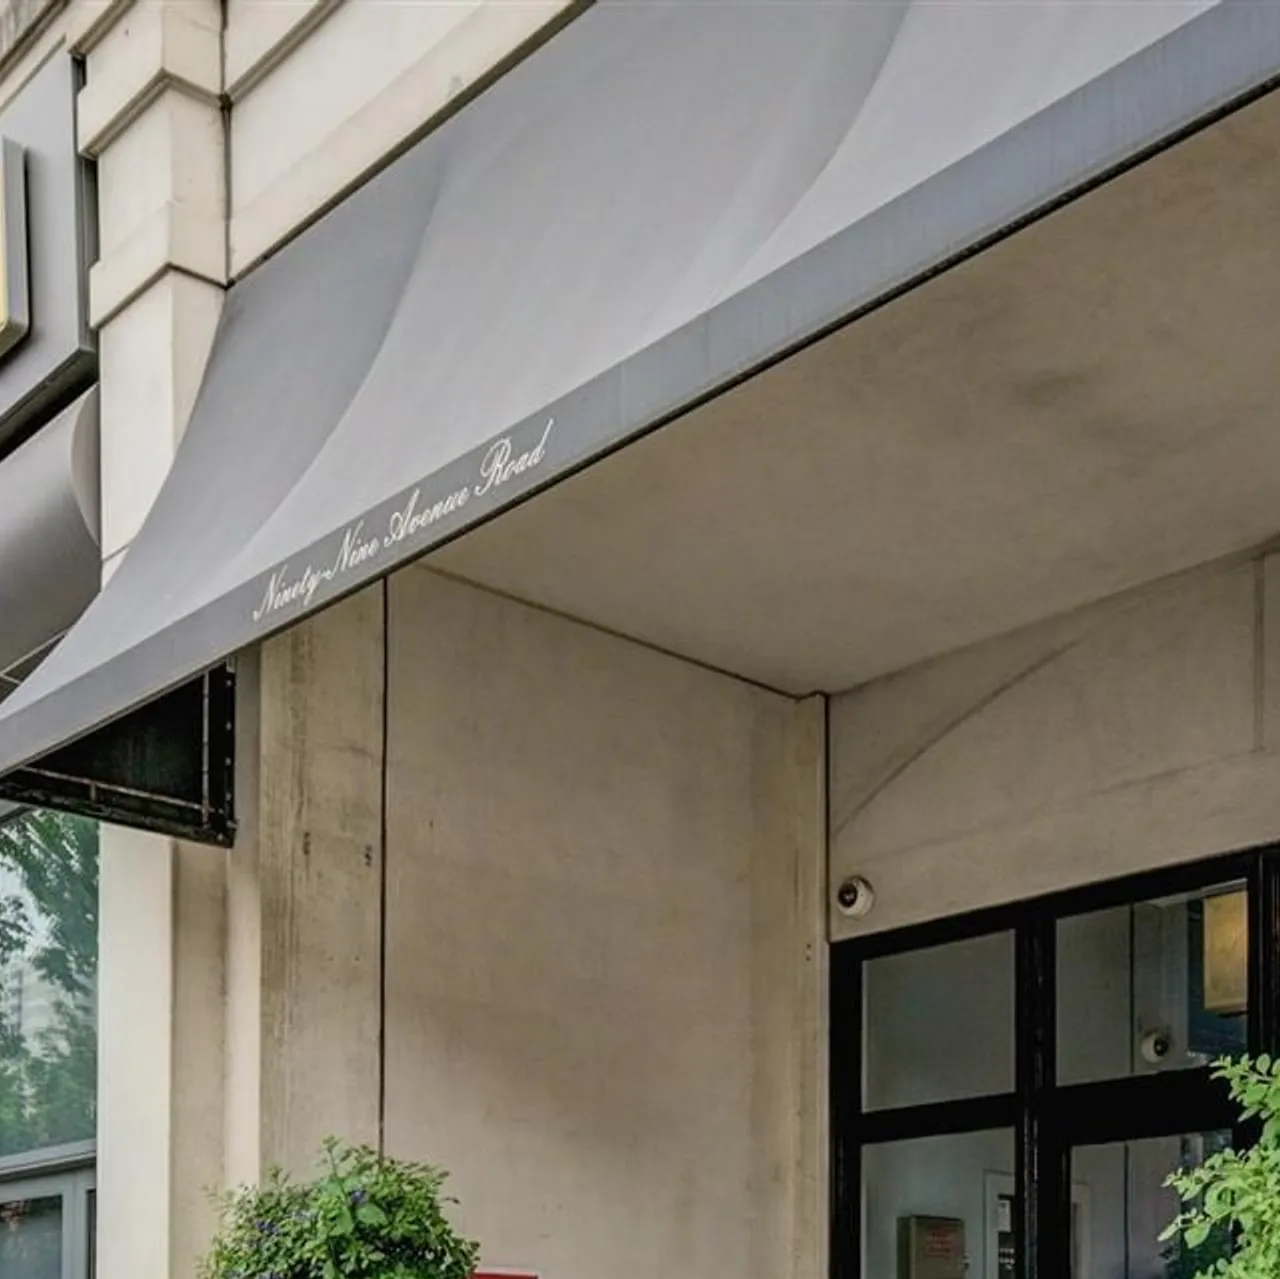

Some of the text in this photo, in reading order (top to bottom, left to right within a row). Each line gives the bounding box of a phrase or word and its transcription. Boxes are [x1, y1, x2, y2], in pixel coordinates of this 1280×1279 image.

[252, 417, 555, 622] Ninety-Nine Avenue Road
